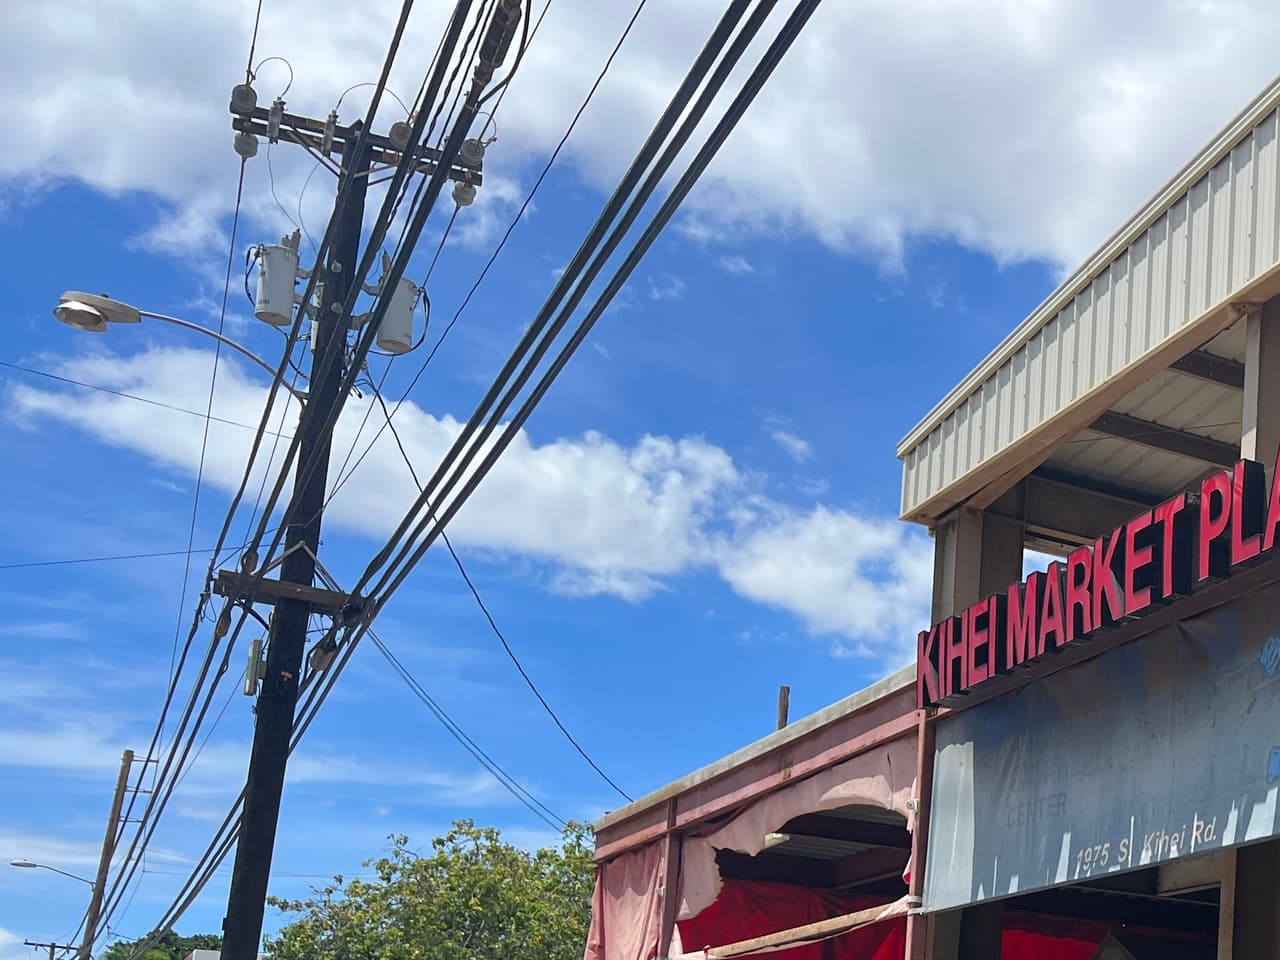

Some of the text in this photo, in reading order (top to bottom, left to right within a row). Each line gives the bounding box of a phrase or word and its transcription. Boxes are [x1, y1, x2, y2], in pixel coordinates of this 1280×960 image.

[917, 593, 998, 708] KIHEI
[1006, 491, 1188, 671] MARKET
[1075, 843, 1111, 872] 1975
[1143, 824, 1187, 856] Kihei
[1191, 815, 1218, 849] Rd.
